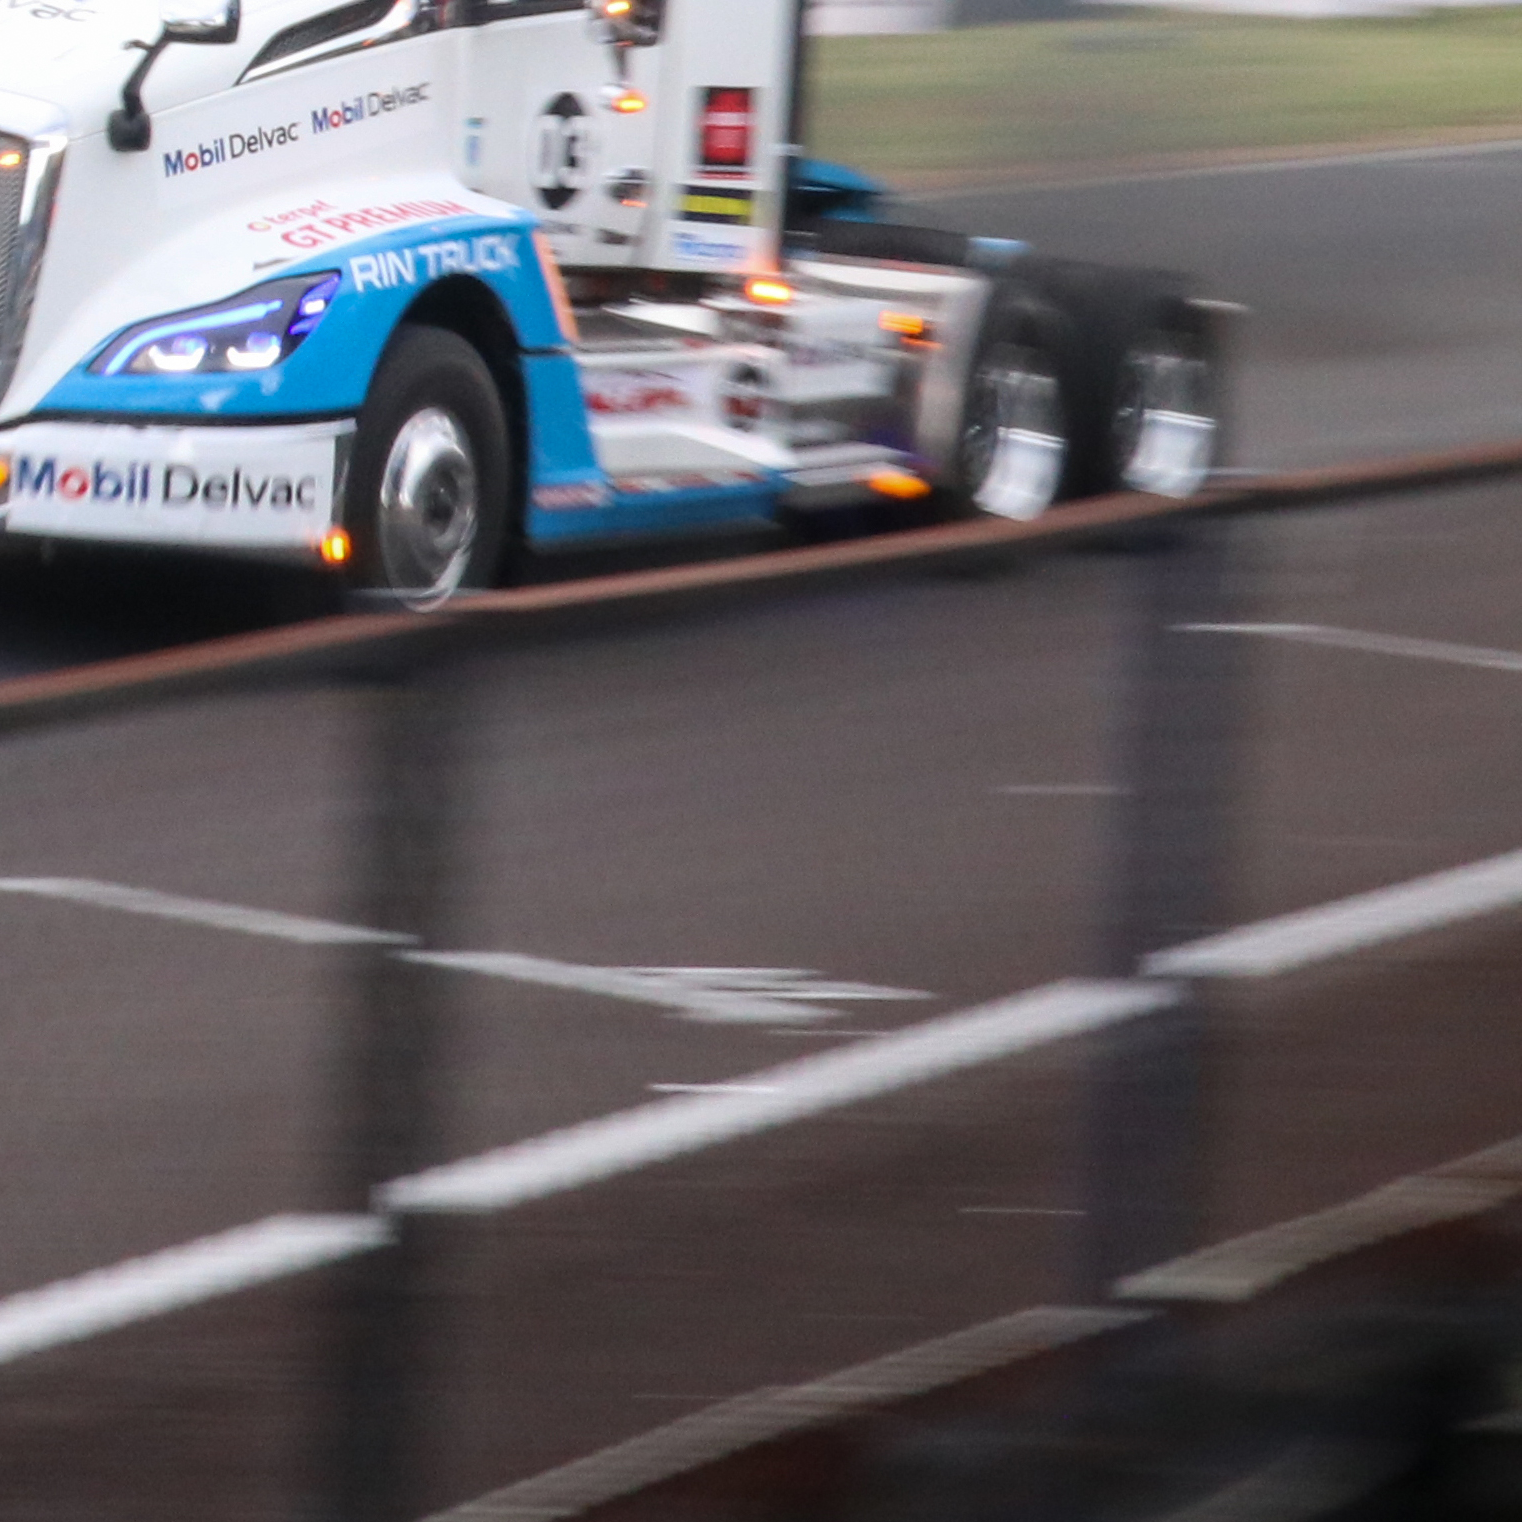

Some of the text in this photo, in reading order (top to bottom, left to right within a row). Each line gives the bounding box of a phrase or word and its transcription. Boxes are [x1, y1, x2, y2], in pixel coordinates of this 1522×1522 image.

[311, 81, 431, 134] Mobil Delvac
[164, 121, 301, 178] Mobil Delvac
[281, 200, 478, 250] GT PREMIUM
[349, 234, 522, 292] RIN TRUCK
[16, 455, 318, 512] Mobil Delvac
